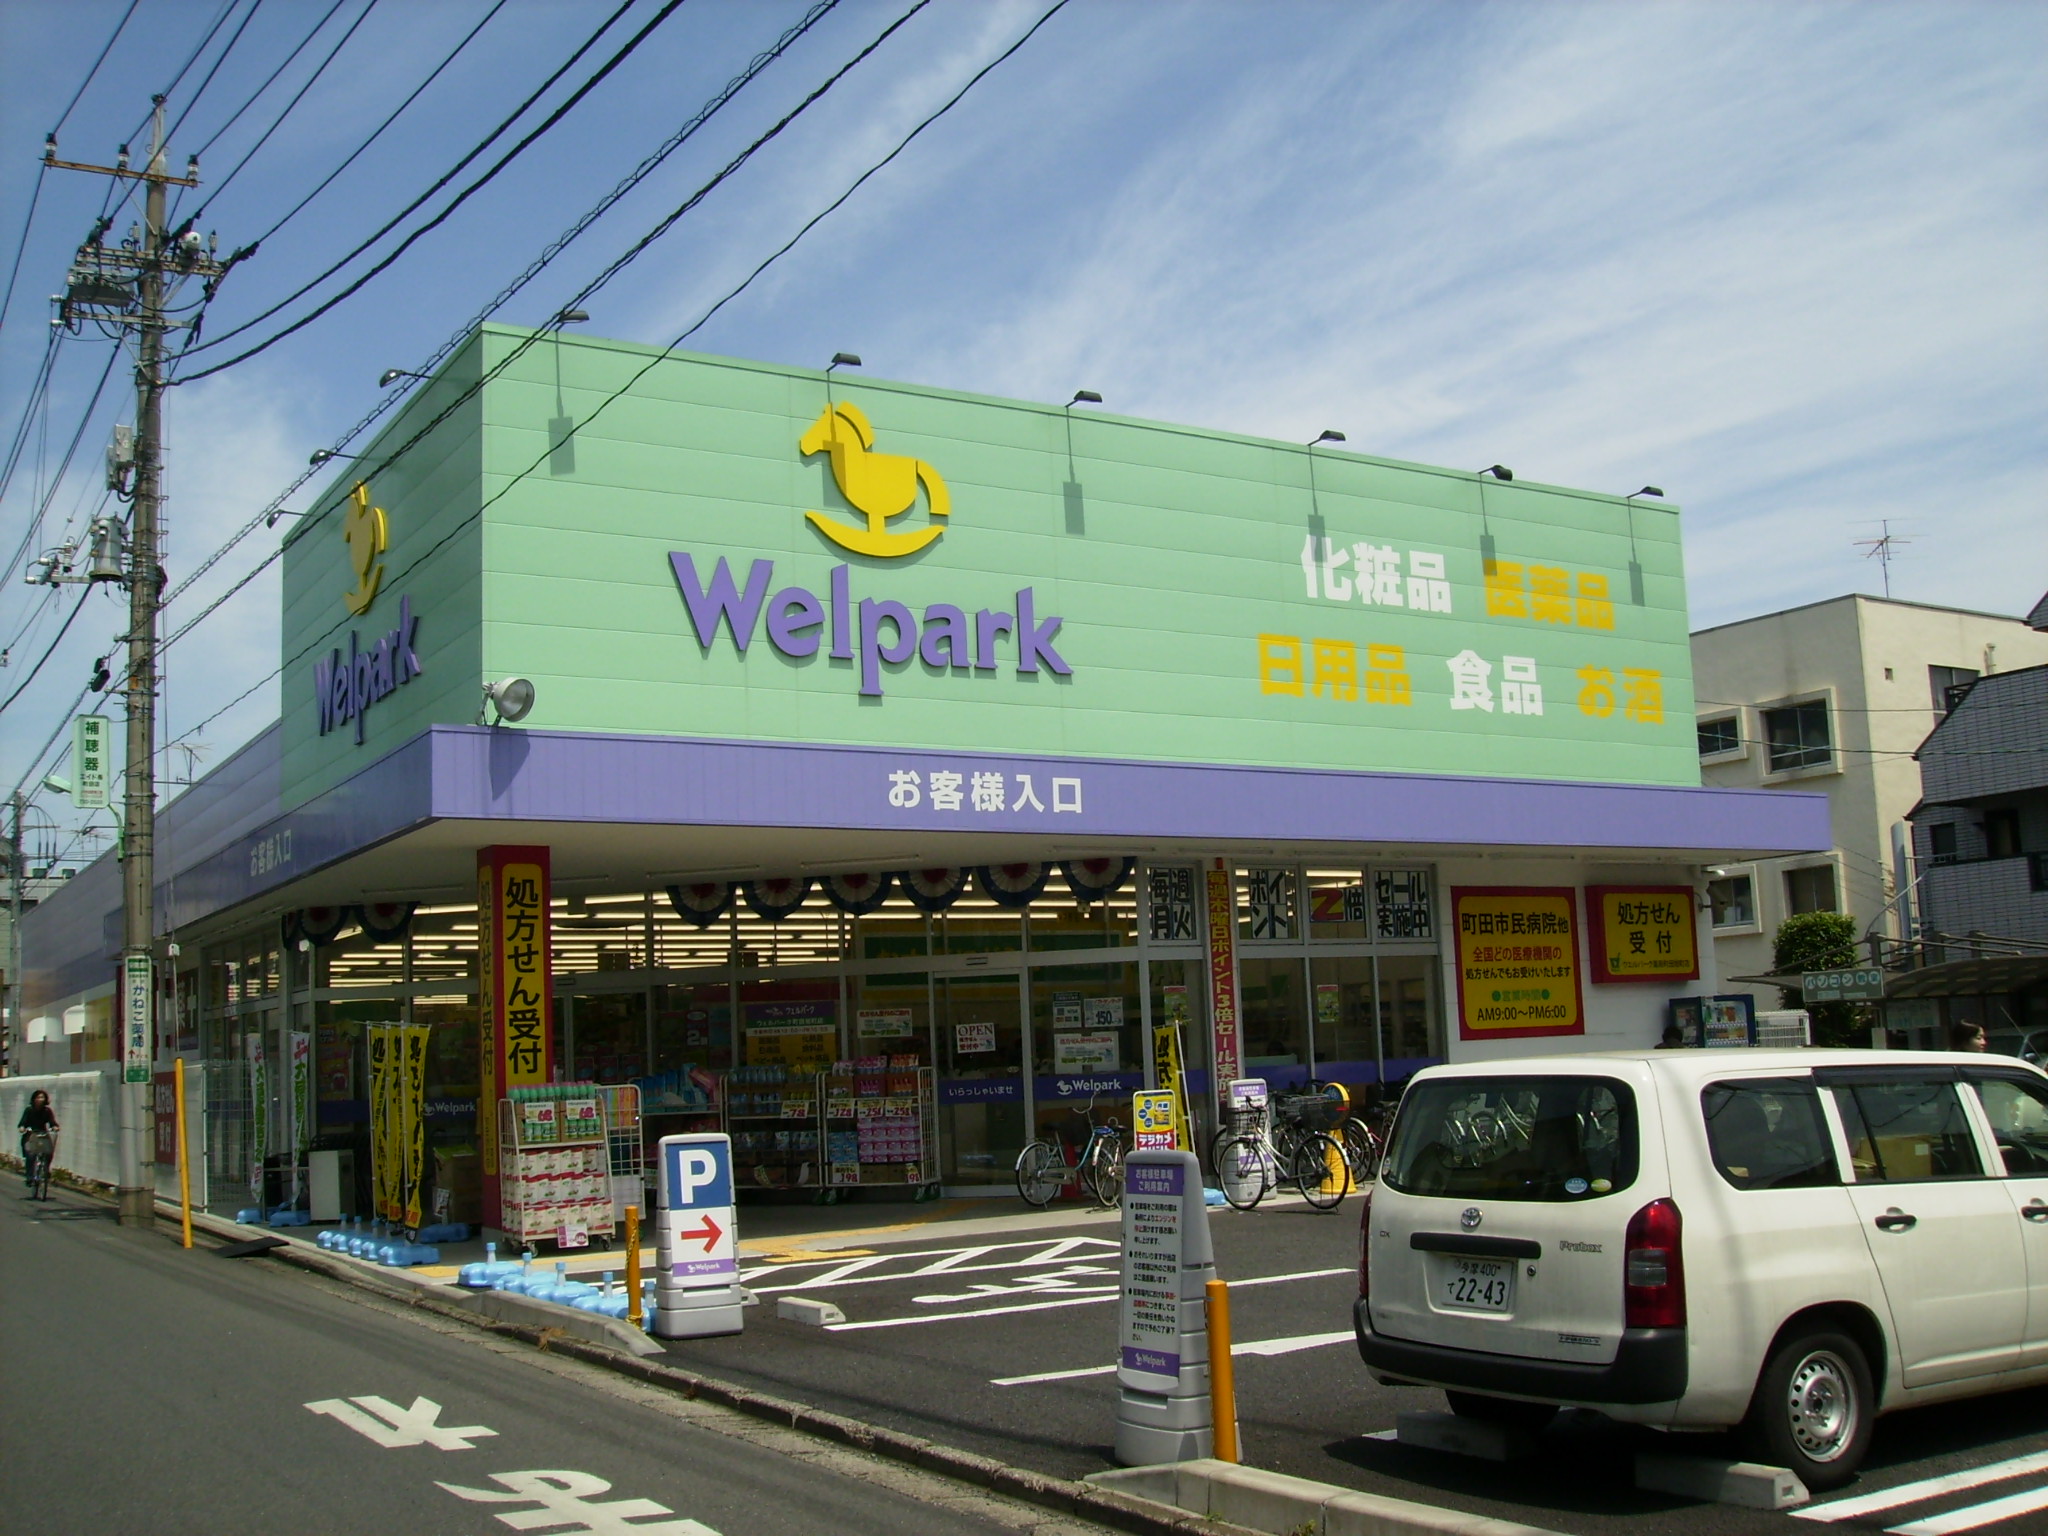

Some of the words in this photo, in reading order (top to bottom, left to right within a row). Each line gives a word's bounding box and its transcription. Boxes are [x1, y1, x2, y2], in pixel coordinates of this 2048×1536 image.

[1301, 534, 1452, 613] 化粧品
[1483, 558, 1615, 630] 医薬品
[669, 551, 1074, 696] Welpark
[314, 594, 421, 746] Welpark
[1258, 633, 1412, 706] 日用品
[1446, 649, 1543, 716] 食品
[1576, 664, 1664, 725] お酒
[888, 770, 1082, 813] お客様入口
[1461, 911, 1569, 935] 町田市民病院他
[1618, 901, 1681, 925] 処方せん
[1473, 946, 1562, 962] 全国どの医療機関の
[1629, 930, 1672, 954] 受付
[506, 876, 543, 1075] 処方せん受付
[1465, 966, 1571, 980] 処方せんでもお受けいたします
[1207, 872, 1237, 1102] 毎週木曜日ポイント3倍セール実施
[958, 1024, 993, 1036] OPEN
[948, 1085, 1014, 1097] いらっしゃいませ
[1072, 1078, 1121, 1093] Welpark
[434, 1101, 477, 1116] Welpark
[679, 1149, 717, 1203] P
[1559, 1240, 1603, 1253] Probox
[695, 1261, 721, 1272] Welpark
[1455, 1277, 1505, 1305] 22-43
[1142, 1353, 1167, 1368] Welpark
